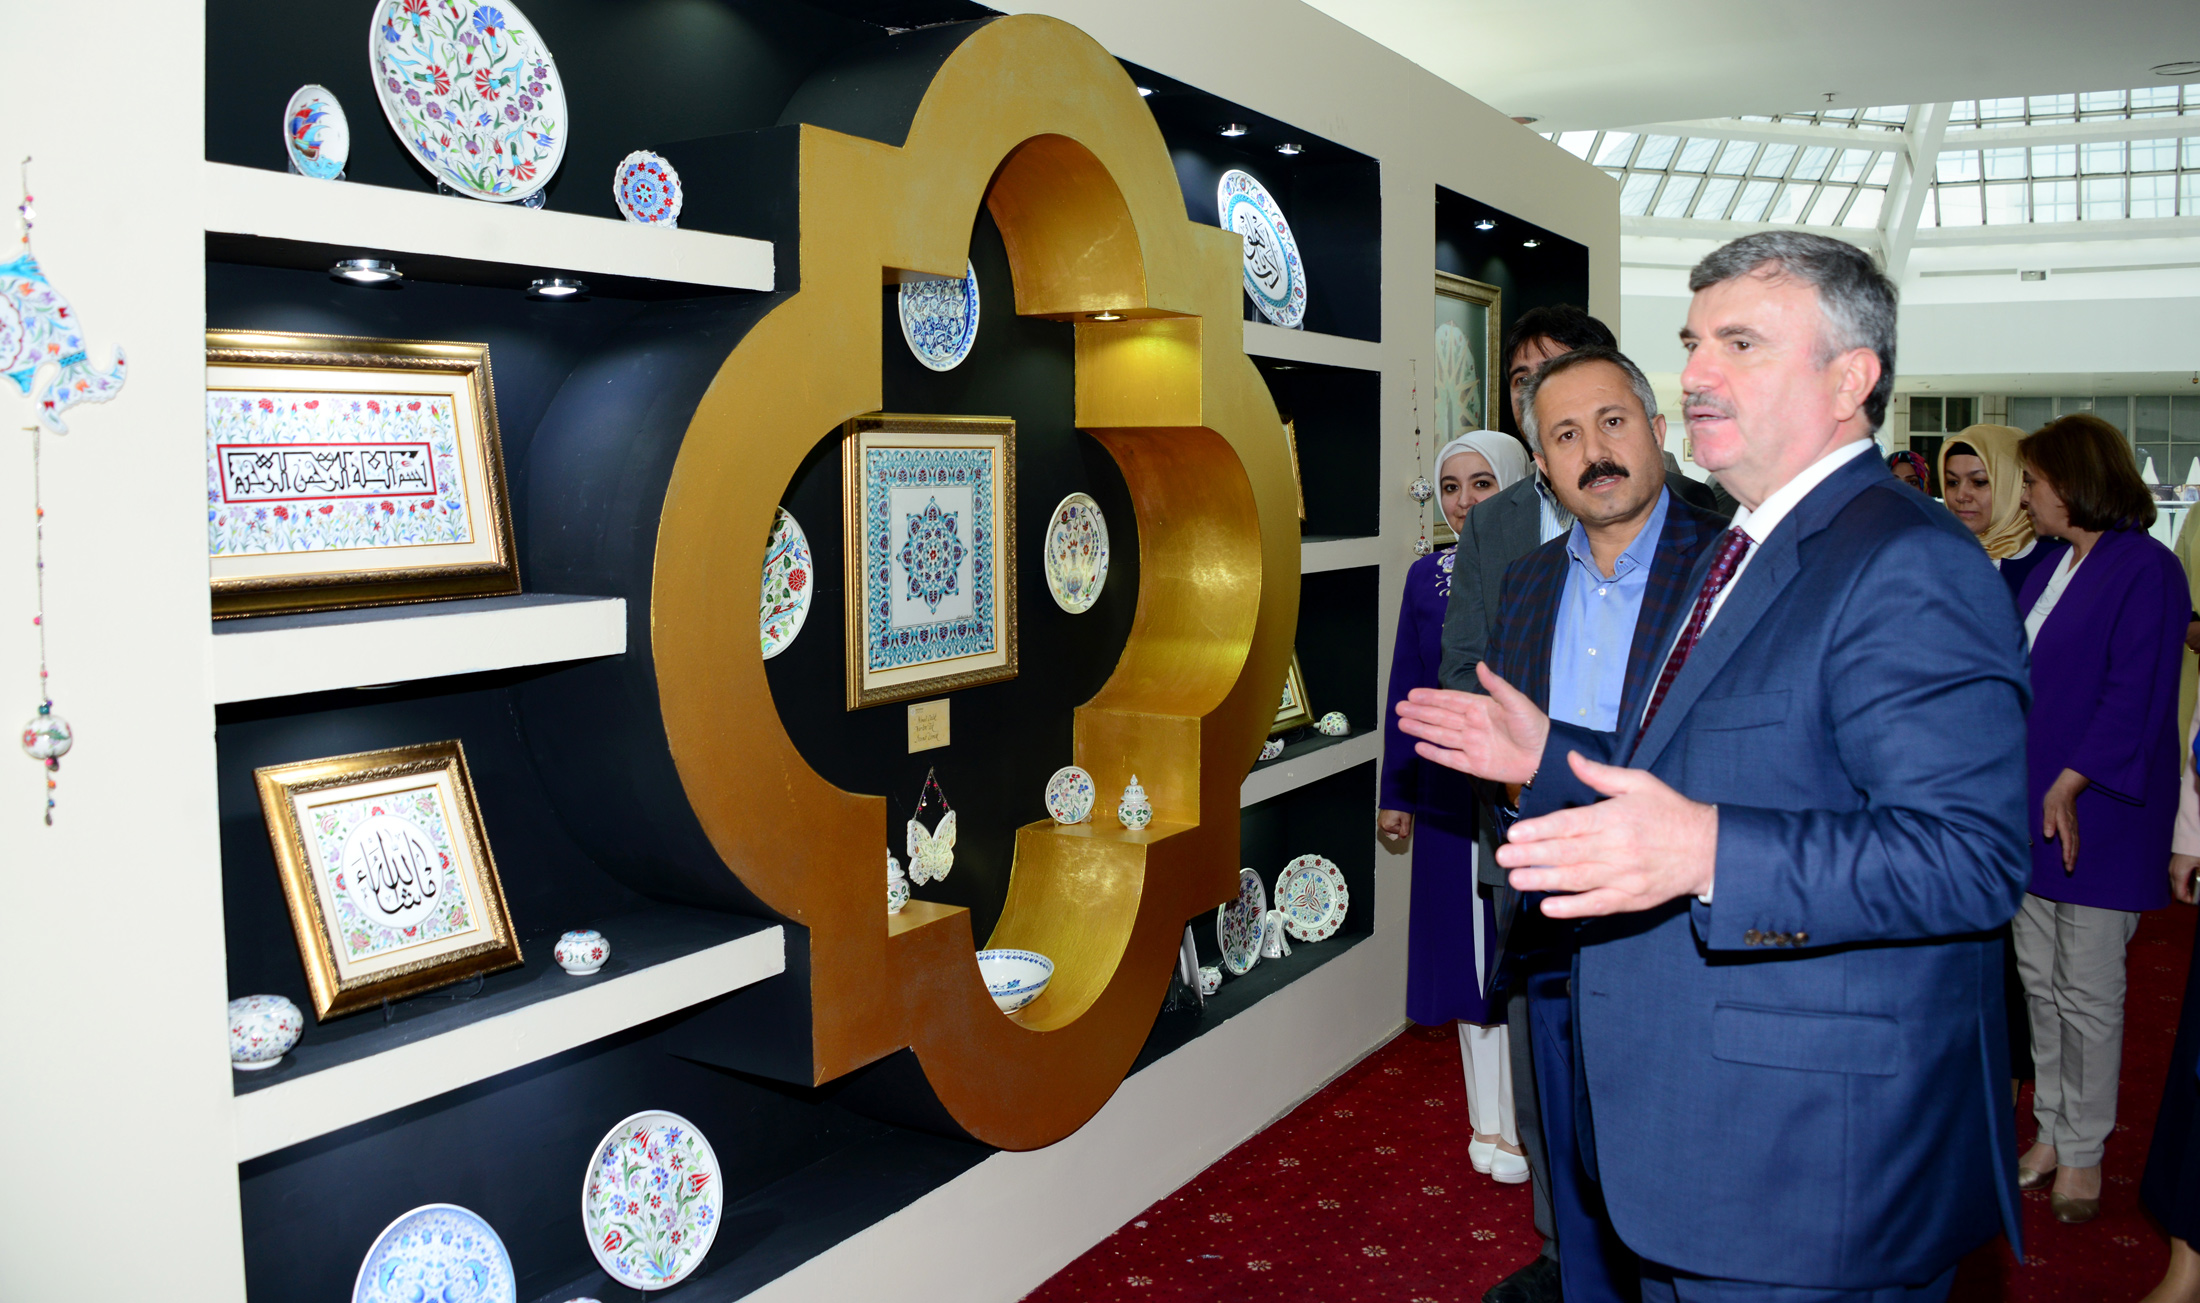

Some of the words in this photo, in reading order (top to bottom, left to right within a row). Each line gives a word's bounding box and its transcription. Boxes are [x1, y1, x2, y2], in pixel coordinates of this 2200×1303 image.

[227, 450, 293, 494] الرحيم
[292, 450, 353, 494] الرحمن
[353, 450, 396, 490] الله
[396, 450, 429, 488] بسم
